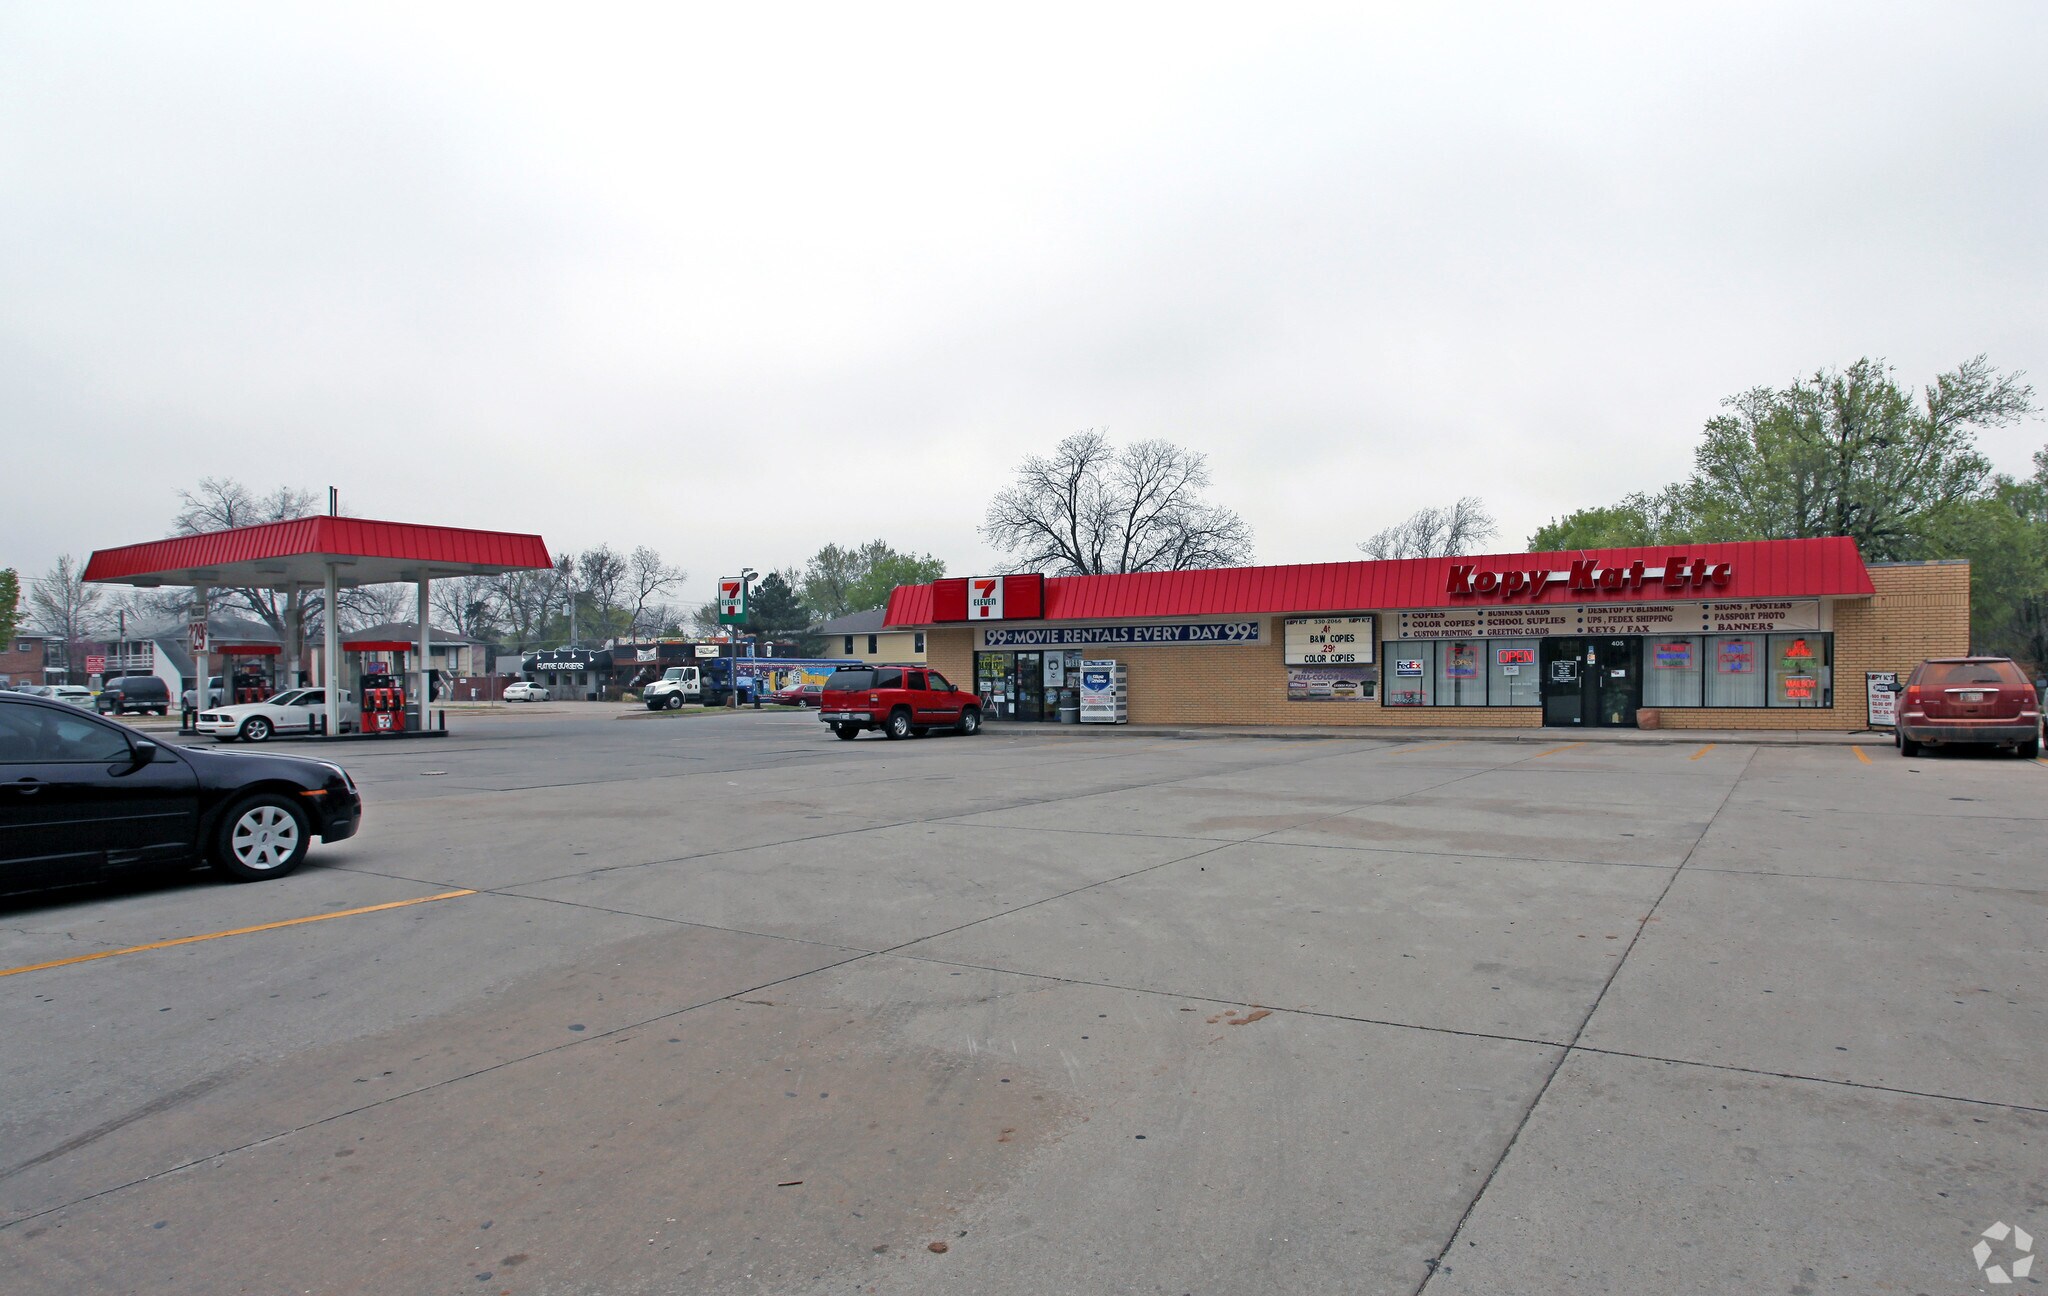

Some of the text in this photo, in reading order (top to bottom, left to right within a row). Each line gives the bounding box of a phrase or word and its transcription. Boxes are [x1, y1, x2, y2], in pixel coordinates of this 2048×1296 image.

[1446, 556, 1732, 599] Kopy Kat Etc
[722, 582, 740, 616] 7
[974, 580, 996, 617] 7
[1626, 605, 1674, 613] PUBLISHING
[1714, 603, 1743, 611] SIGNS
[1750, 602, 1793, 610] POSTERS
[1488, 609, 1523, 617] BUSINESS
[1714, 611, 1786, 621] PASSPORT PHOTO
[1487, 617, 1566, 626] SCHOOL SUPLIES
[1608, 615, 1634, 623] FEDEX
[1636, 614, 1673, 622] SHIPPING
[1412, 619, 1476, 628] COLOR COPIES
[1717, 622, 1774, 631] BANNERS
[1441, 629, 1473, 637] PRINTING
[1487, 627, 1550, 636] GREETING CARDS
[1587, 625, 1616, 633] KEYS
[1627, 625, 1650, 633] FAX
[1013, 630, 1059, 644] MOVIE
[1064, 627, 1128, 643] RENTALS
[1133, 626, 1182, 641] EVERY
[1189, 625, 1222, 640] DAY
[1310, 633, 1355, 644] B&W COPIES
[1304, 653, 1355, 663] COLOR COPIES
[1499, 650, 1533, 663] OPEN
[1397, 661, 1421, 670] FedEx
